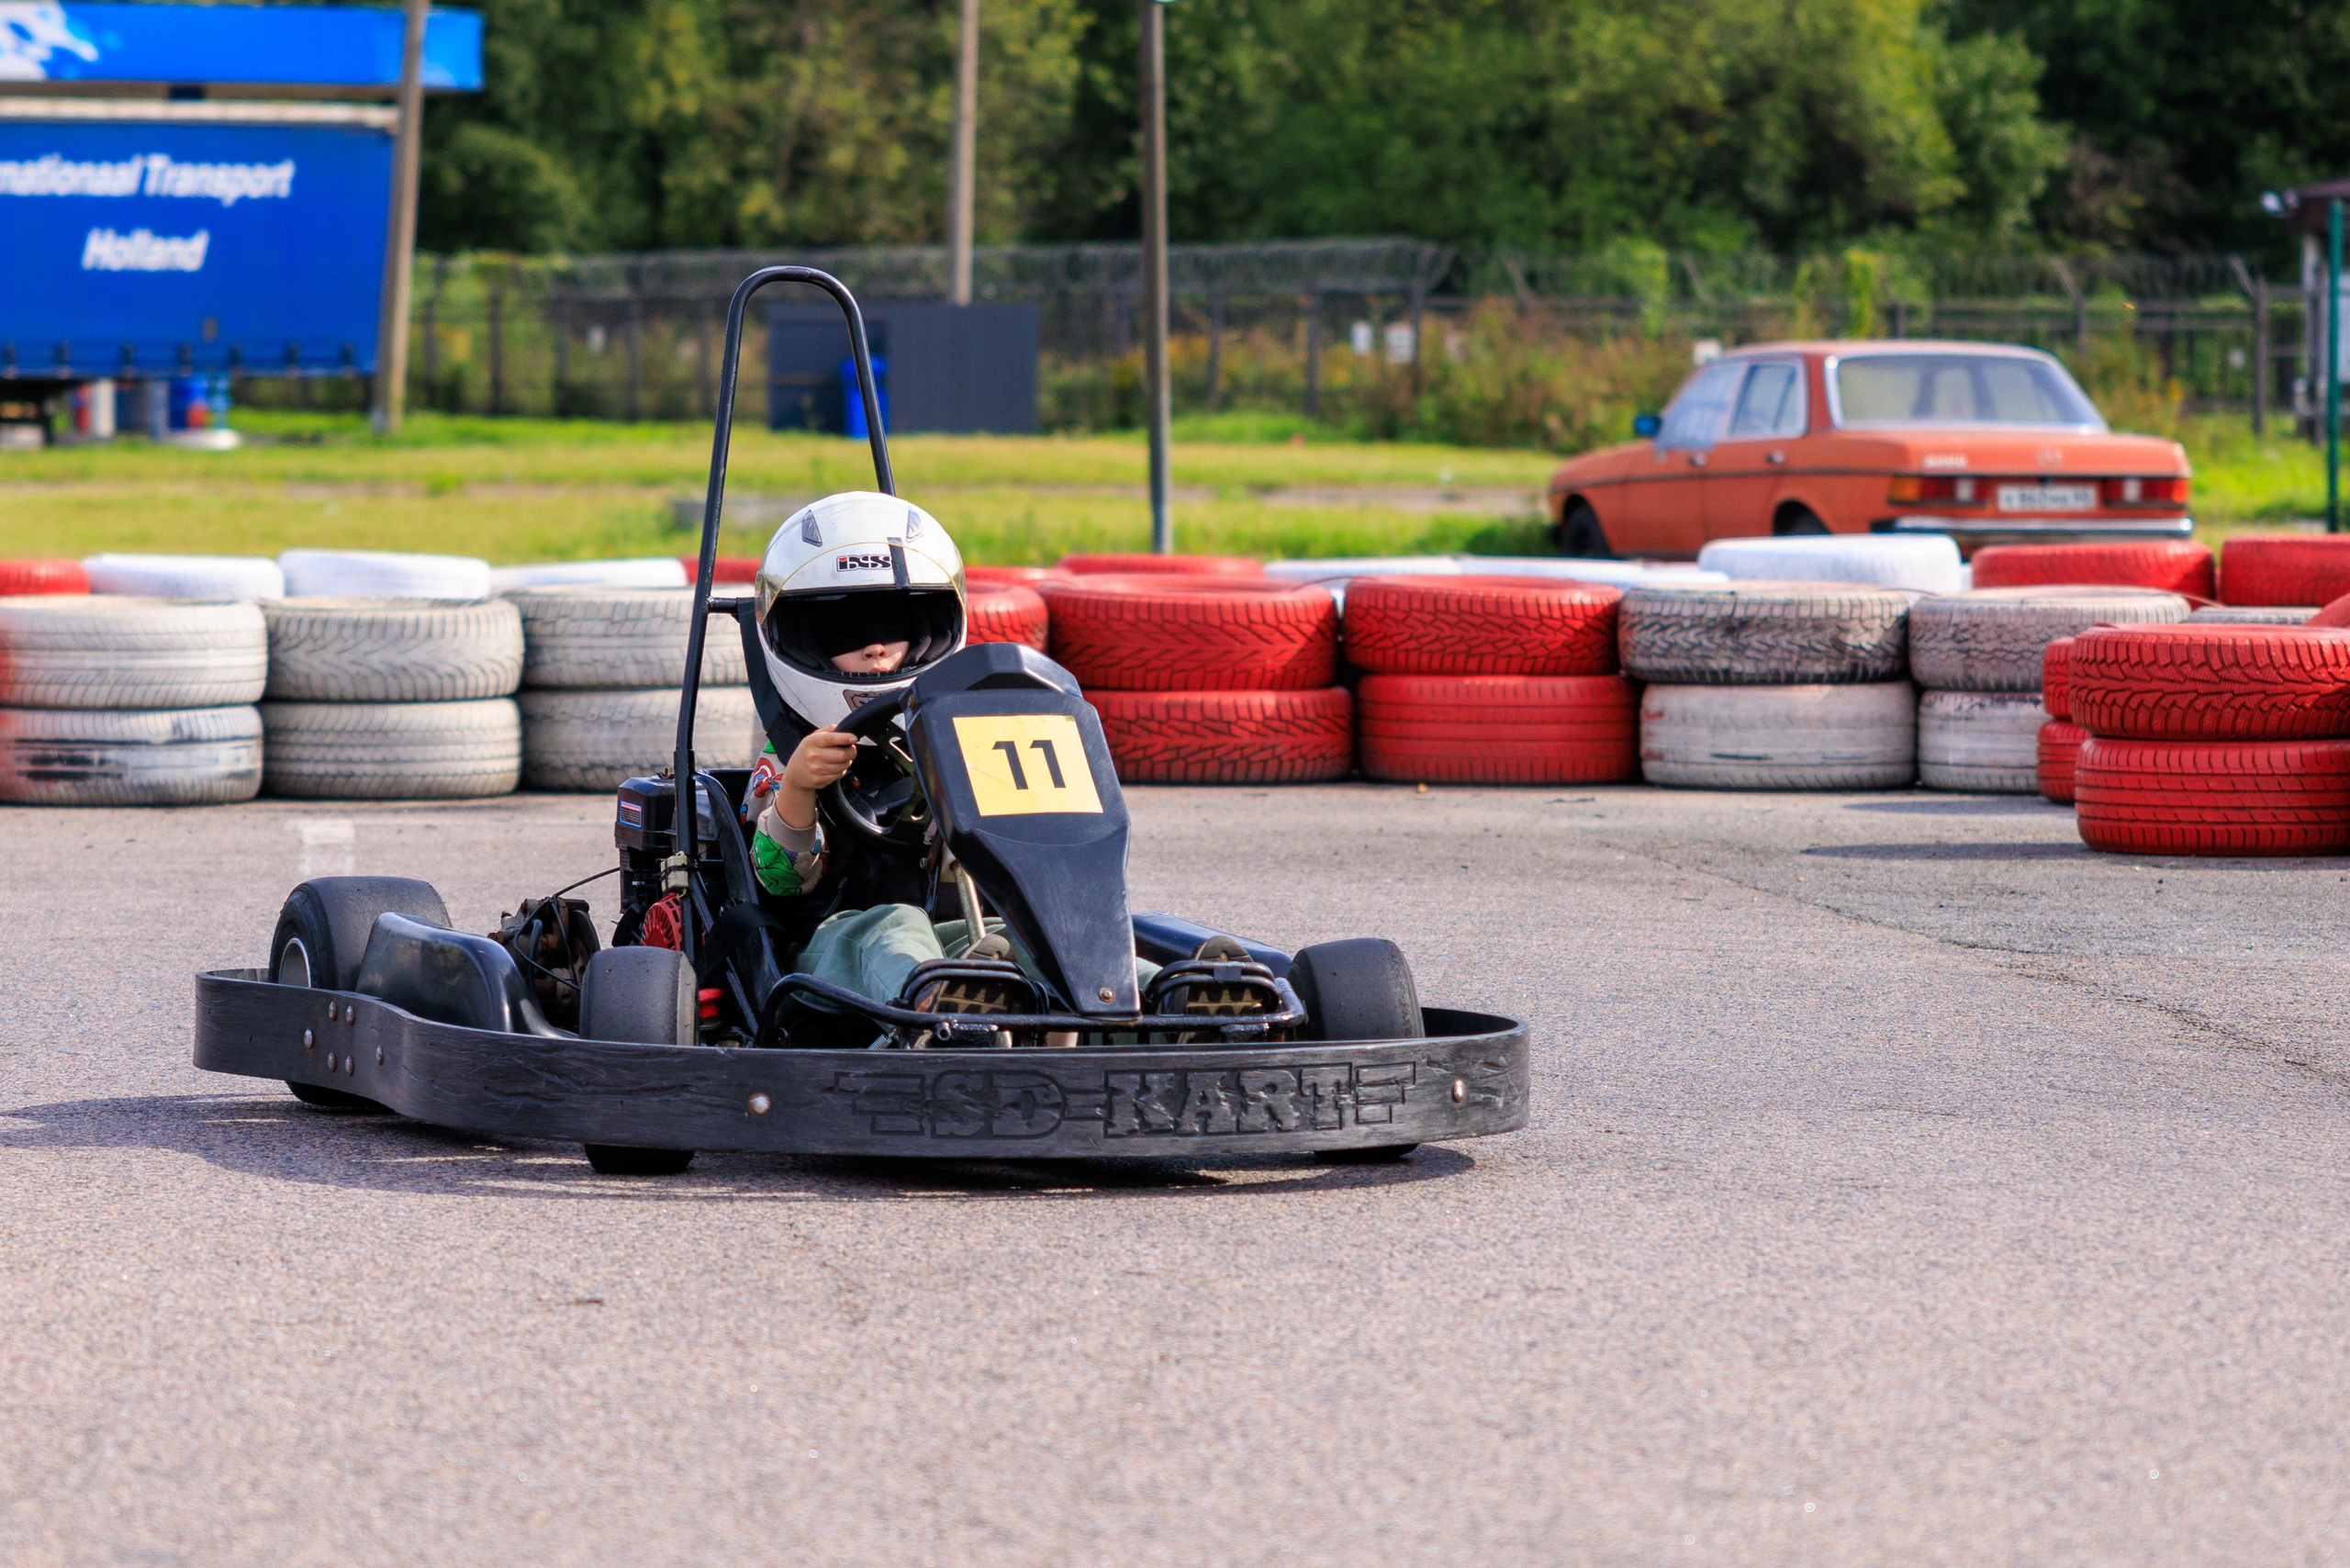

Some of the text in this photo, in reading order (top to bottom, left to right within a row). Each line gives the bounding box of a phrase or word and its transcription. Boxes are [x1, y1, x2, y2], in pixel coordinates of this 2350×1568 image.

[144, 152, 296, 207] Transport
[81, 228, 210, 272] Holland
[992, 740, 1066, 790] 11
